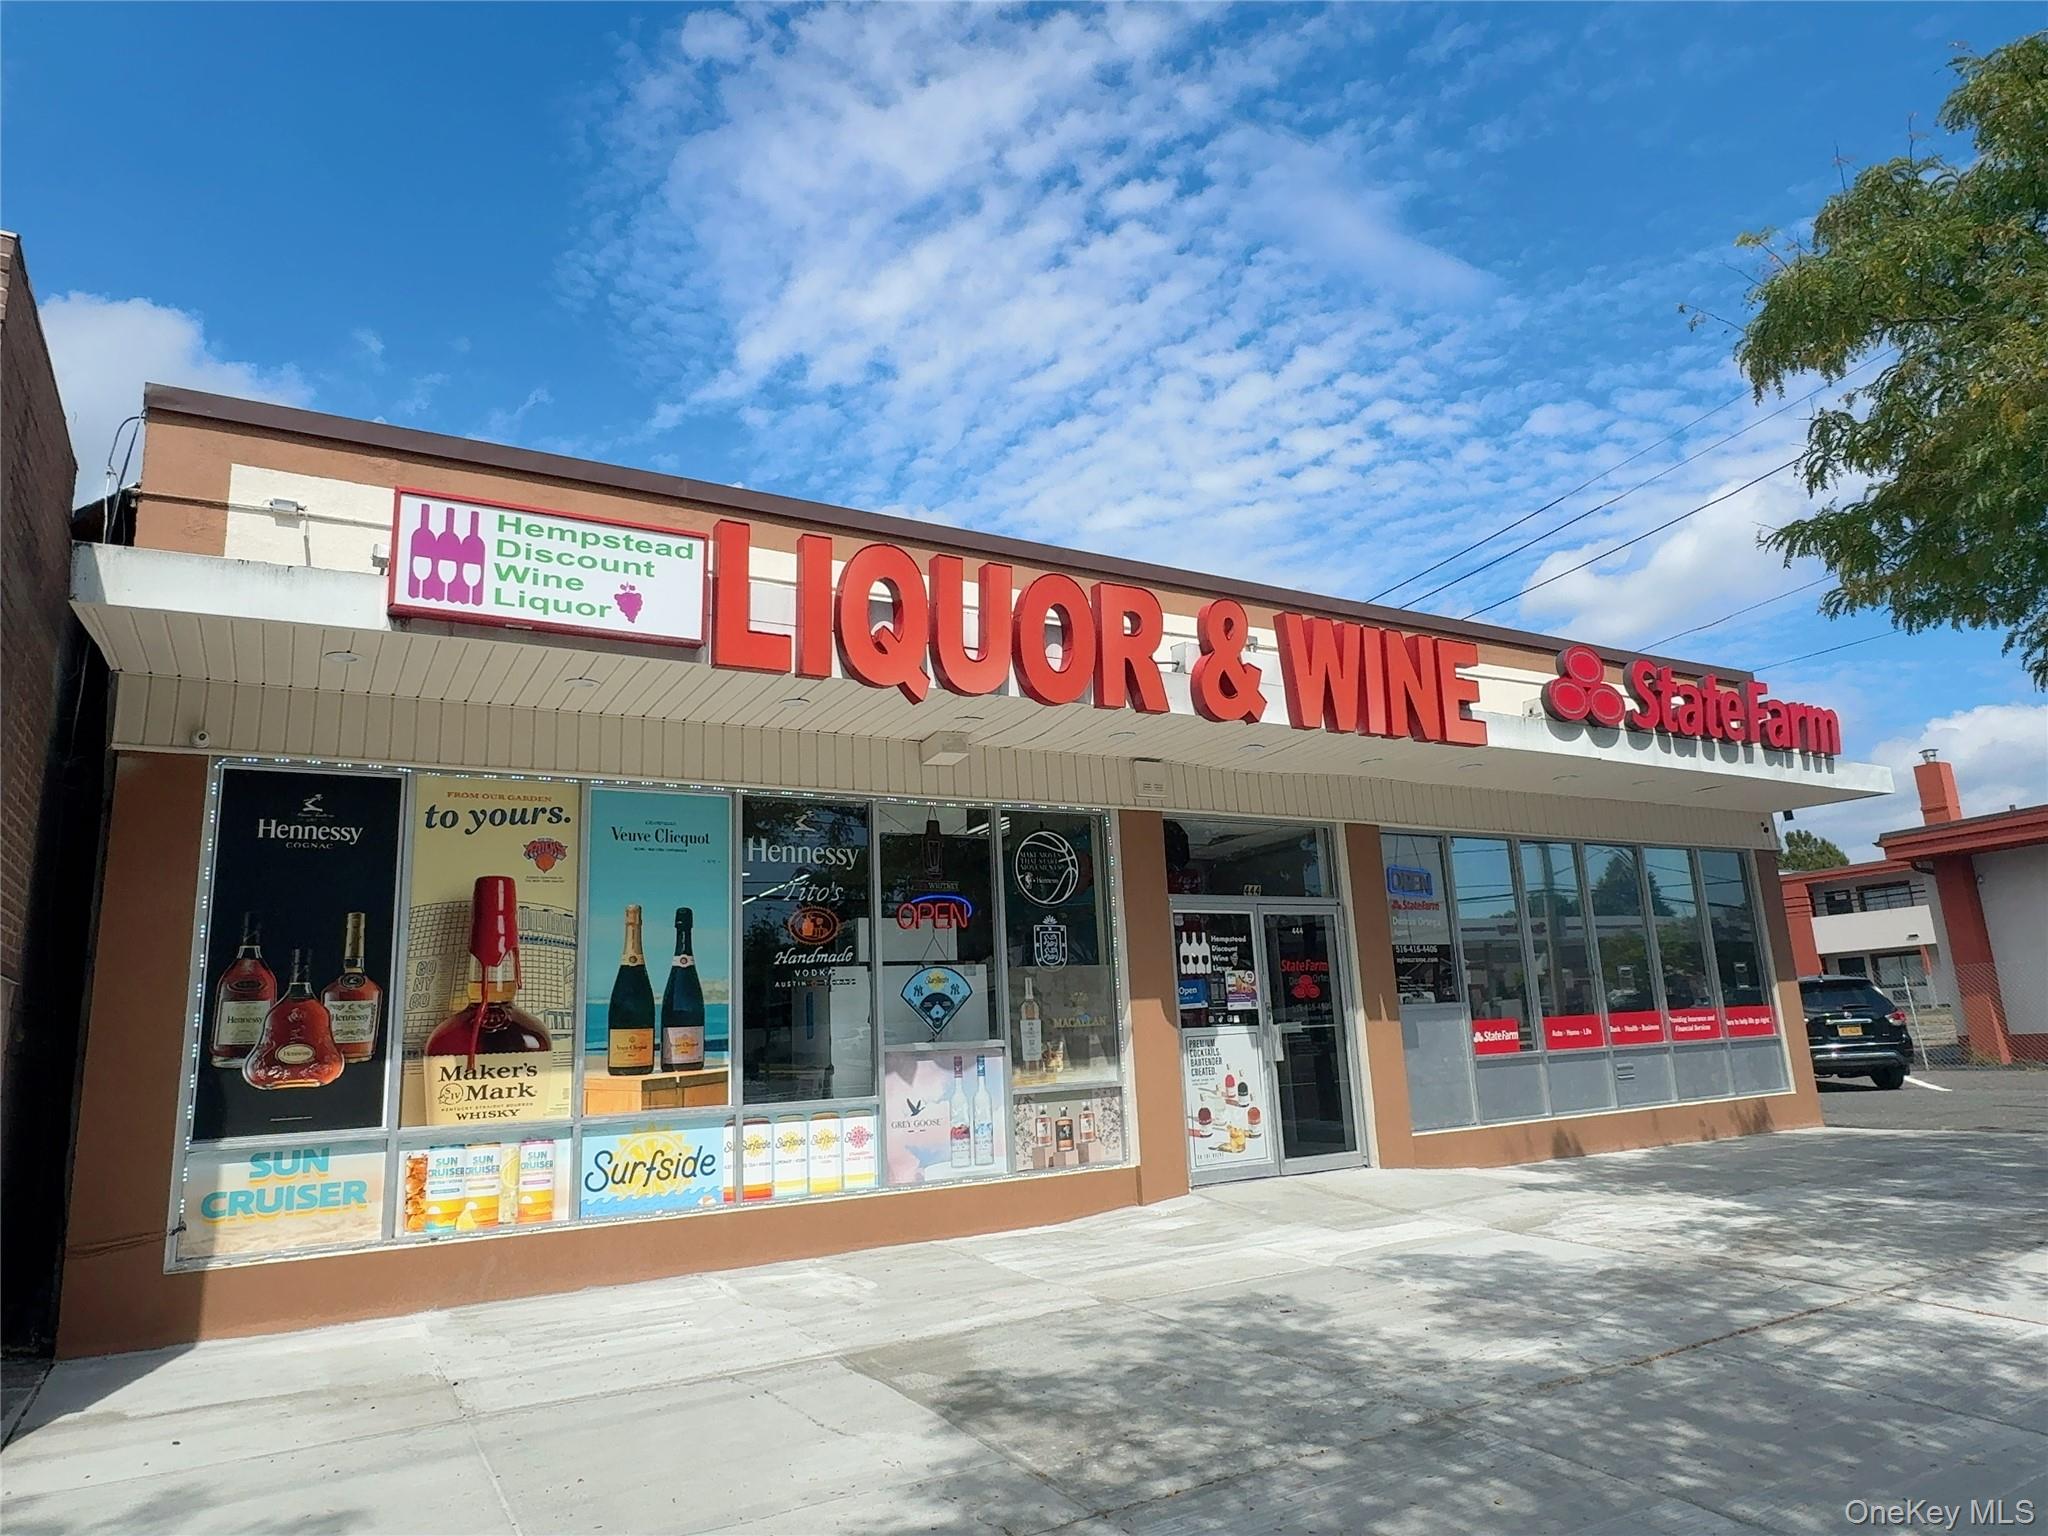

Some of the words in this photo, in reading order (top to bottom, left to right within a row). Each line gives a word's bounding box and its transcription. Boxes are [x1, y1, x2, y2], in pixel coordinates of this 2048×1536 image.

[497, 514, 694, 560] Hempstead
[497, 539, 655, 578] Discount
[494, 563, 584, 591] Wine
[494, 587, 612, 618] Liquor
[711, 519, 1170, 714] LIQUOR
[1191, 599, 1268, 724] &
[1273, 611, 1487, 746] WINE
[1623, 659, 1840, 755] StateFarm
[447, 792, 479, 800] FROM
[482, 793, 505, 801] OUR
[507, 794, 552, 803] GARDEN
[425, 804, 459, 829] to
[465, 806, 571, 835] yours.
[257, 818, 363, 846] Hennessy
[611, 826, 651, 842] Veuve
[655, 828, 711, 847] Clicquot
[748, 837, 859, 870] Hennessy
[784, 882, 844, 902] Tito's
[1244, 884, 1262, 896] 444
[896, 902, 968, 930] OPEN
[1210, 935, 1247, 944] Hempstead
[1291, 927, 1303, 935] 444
[773, 945, 854, 965] Handmade
[794, 969, 836, 977] VODKA
[1281, 959, 1329, 972] StateFarm
[775, 980, 807, 988] AUSTIN
[1179, 986, 1198, 995] Open
[1052, 1015, 1107, 1028] MACALLAN
[1189, 1039, 1215, 1048] PREMIUM
[1484, 1030, 1519, 1042] StateFarm
[1191, 1057, 1222, 1067] BARTENDER
[438, 1063, 538, 1082] Maker's
[465, 1082, 536, 1101] Mark
[456, 1109, 520, 1120] WHISKY
[891, 1120, 911, 1129] GREY
[913, 1118, 941, 1127] GOOSE
[249, 1147, 330, 1183] SUN
[436, 1157, 458, 1166] SUN
[473, 1155, 494, 1165] SUN
[527, 1151, 548, 1160] SUN
[428, 1167, 464, 1178] CRUISER
[465, 1165, 500, 1175] CRUISER
[520, 1160, 553, 1170] CRUISER
[584, 1145, 716, 1192] Surfside
[201, 1180, 367, 1224] CRUISER
